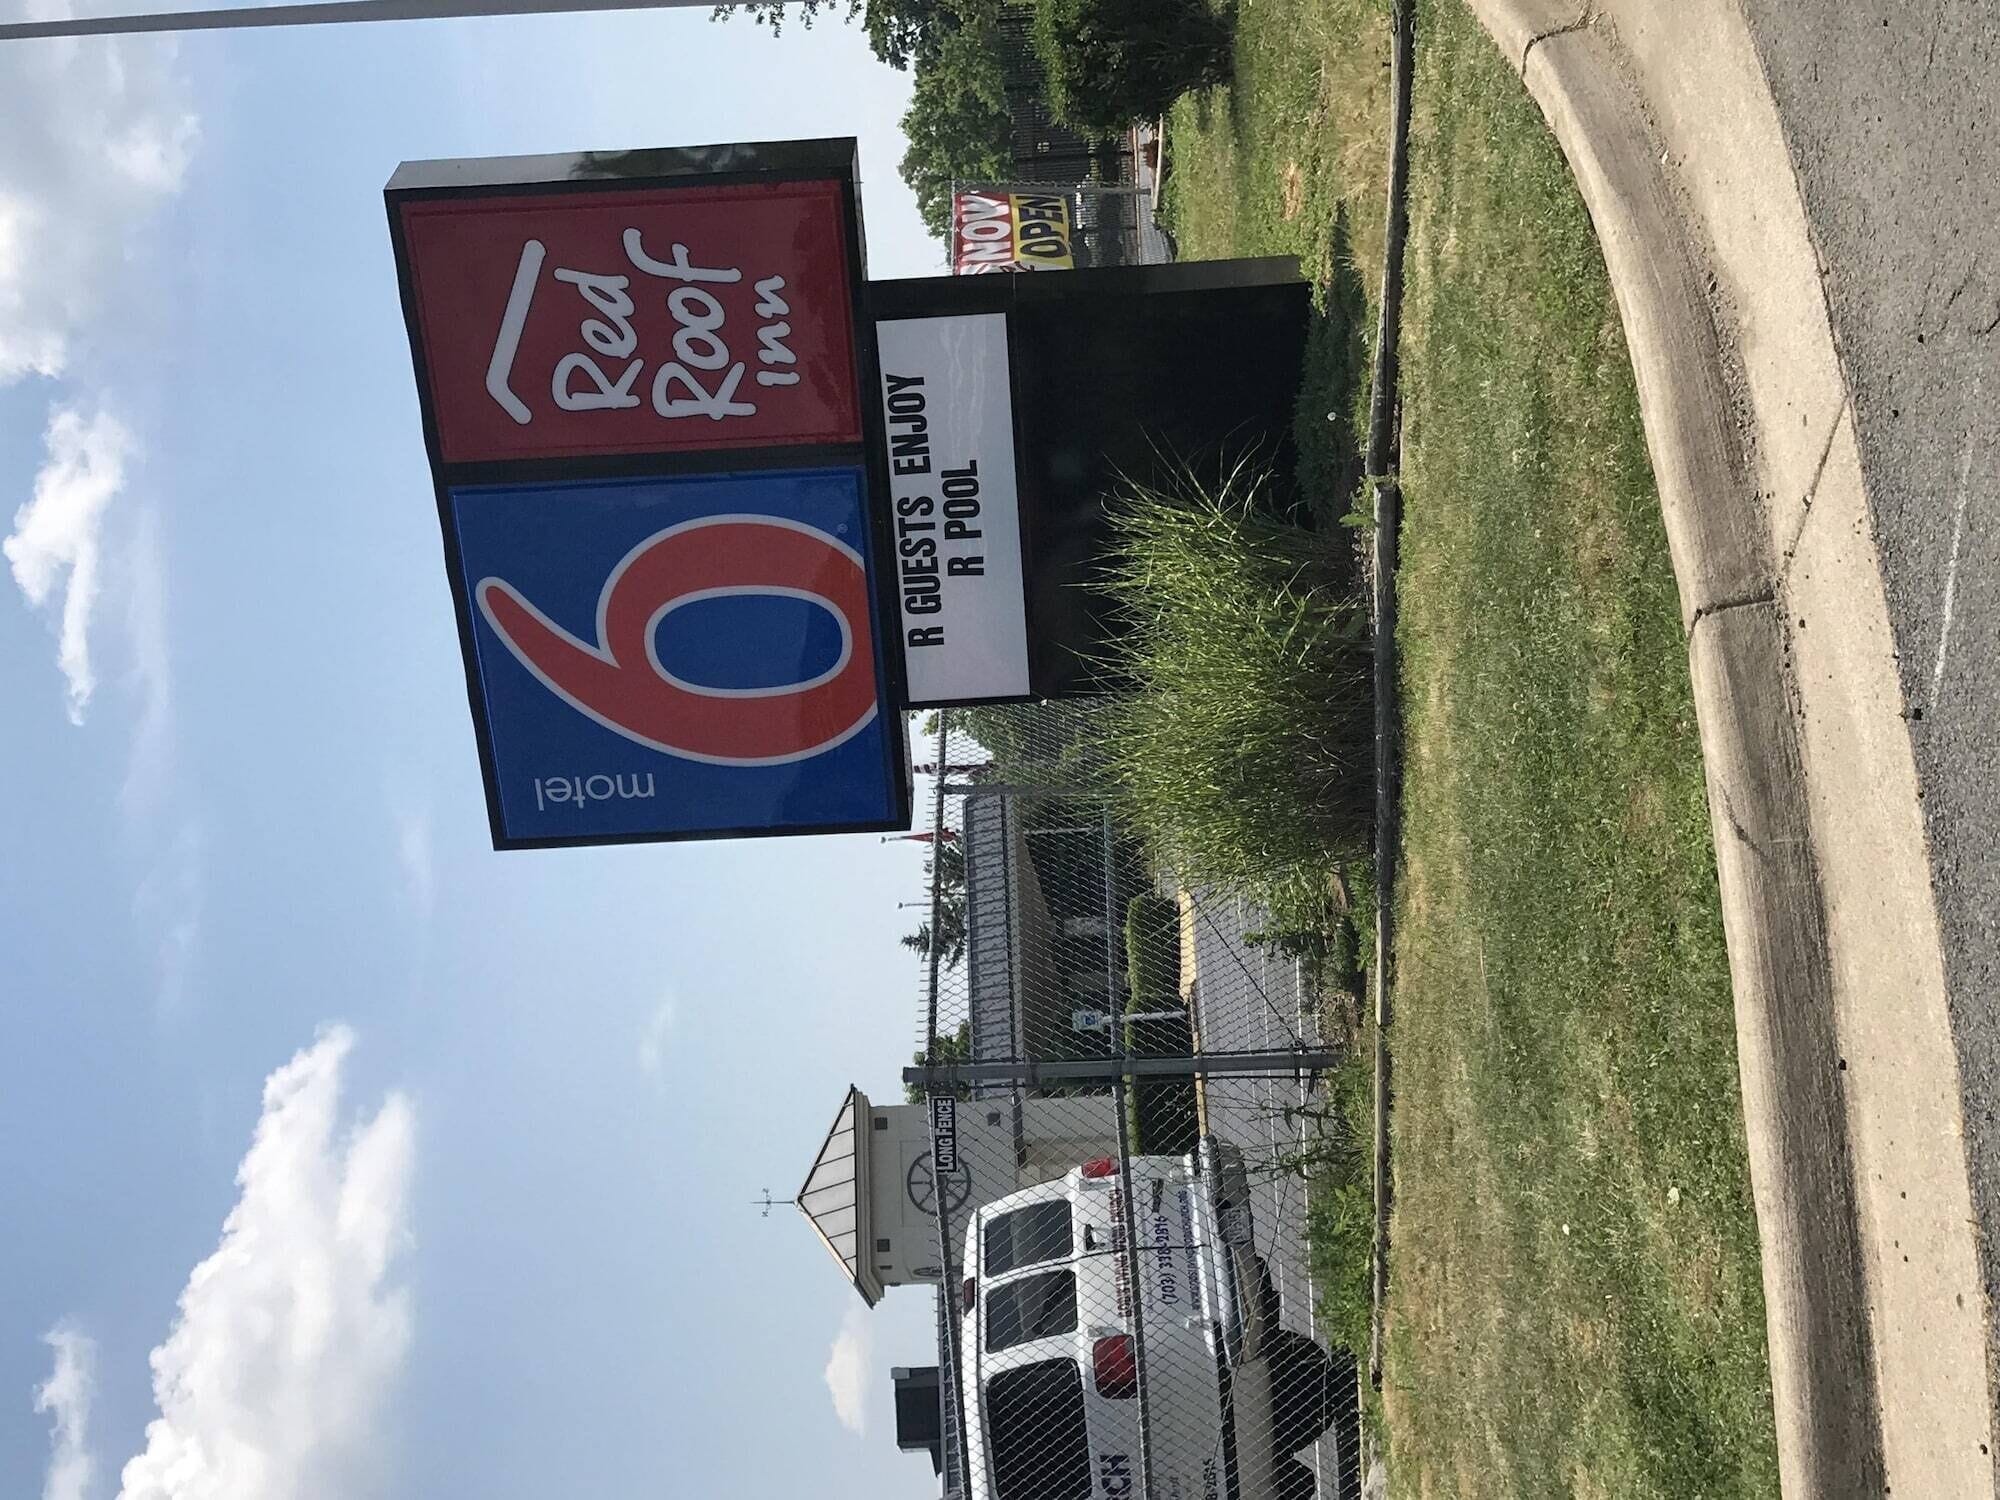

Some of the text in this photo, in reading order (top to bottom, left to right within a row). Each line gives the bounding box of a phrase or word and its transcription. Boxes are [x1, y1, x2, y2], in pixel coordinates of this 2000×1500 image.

[960, 194, 1012, 262] NOW
[1015, 195, 1067, 259] OPEN
[551, 267, 645, 412] Red
[622, 227, 757, 421] Roof
[885, 373, 944, 648] R GUESTS ENJOY
[940, 459, 985, 577] R POOL
[475, 513, 879, 767] 6
[534, 772, 656, 812] motel
[934, 1099, 954, 1171] LONG FENCE
[1158, 1272, 1180, 1305] (703)
[1099, 1458, 1130, 1500] CH
